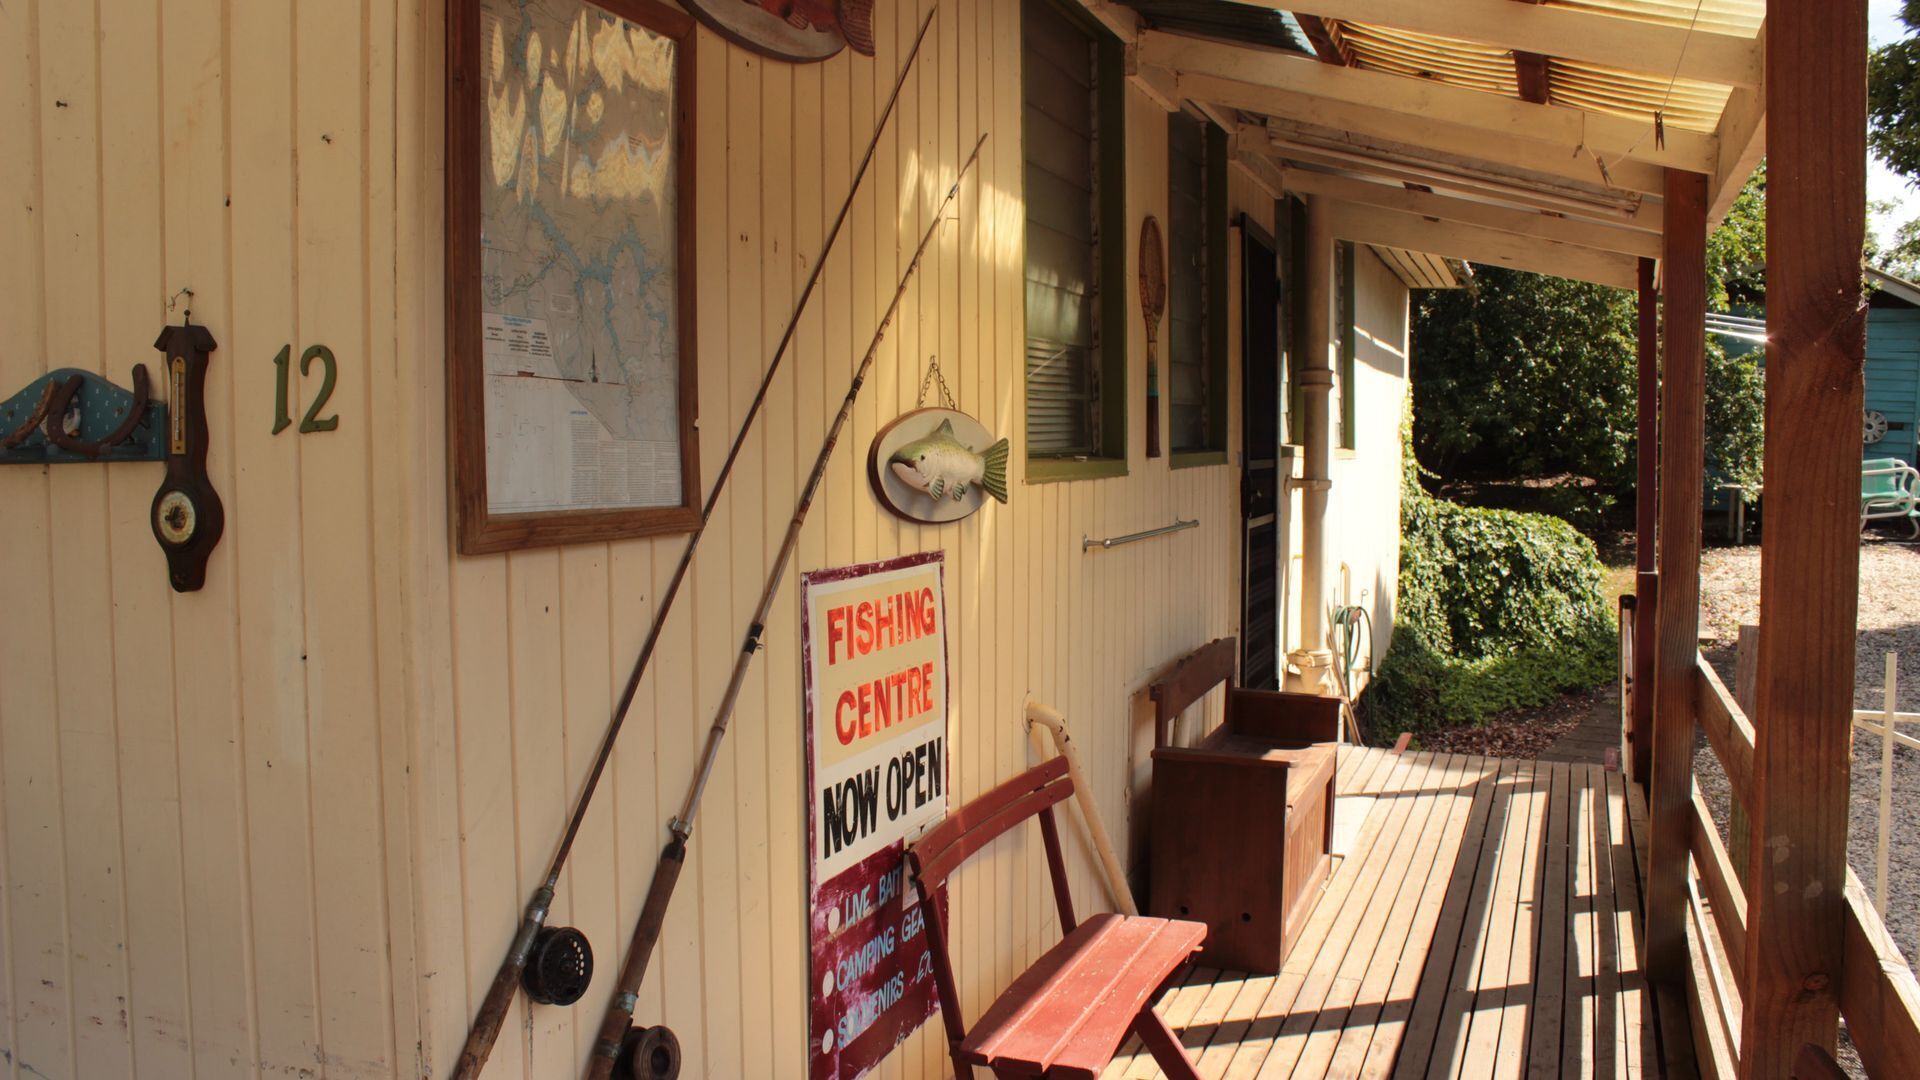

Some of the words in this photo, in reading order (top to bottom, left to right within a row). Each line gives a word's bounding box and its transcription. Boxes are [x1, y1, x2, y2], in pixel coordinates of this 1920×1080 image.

[272, 344, 339, 435] 12
[827, 587, 936, 666] FISHING
[835, 661, 934, 746] CENTRE
[823, 765, 880, 859] NOW
[886, 737, 942, 821] OPEN
[845, 884, 871, 928] LIVE
[879, 865, 903, 906] BAIT
[836, 926, 895, 991] CAMPING
[902, 906, 926, 942] GEA
